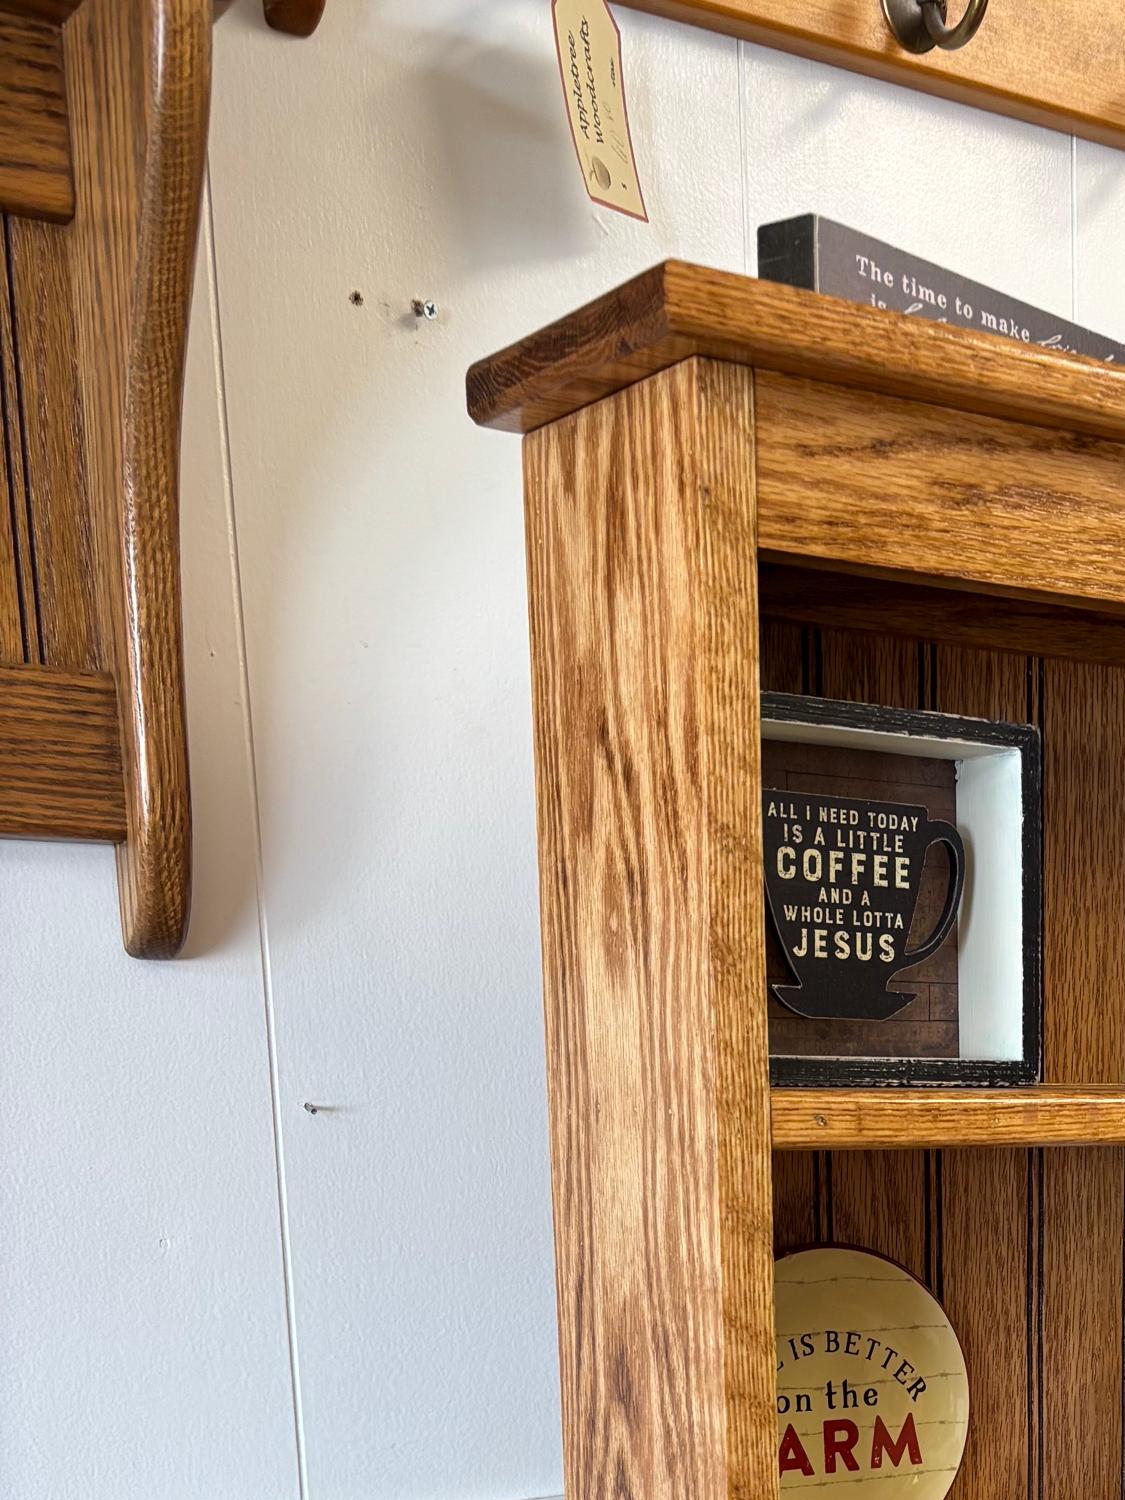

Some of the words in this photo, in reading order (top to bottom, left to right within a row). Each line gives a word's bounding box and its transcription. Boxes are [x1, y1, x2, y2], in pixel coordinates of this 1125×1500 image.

[568, 30, 590, 139] Appletree
[579, 16, 604, 144] Woodcrafts
[855, 254, 894, 288] The
[902, 274, 947, 309] time
[955, 296, 973, 319] to
[981, 310, 1030, 343] make
[768, 802, 798, 819] ALL
[806, 805, 811, 820] I
[819, 806, 859, 825] NEED
[867, 812, 919, 832] TODAY
[783, 823, 803, 843] IS
[814, 827, 826, 846] A
[837, 829, 904, 853] LITTLE
[776, 846, 910, 890] COFFEE
[818, 887, 852, 905] AND
[861, 890, 871, 906] A
[783, 905, 844, 925] WHOLE
[853, 910, 904, 930] LOTTA
[792, 928, 895, 963] JESUS
[788, 1333, 815, 1360] IS
[824, 1331, 927, 1402] BETTER
[777, 1393, 813, 1414] on
[825, 1379, 878, 1410] the
